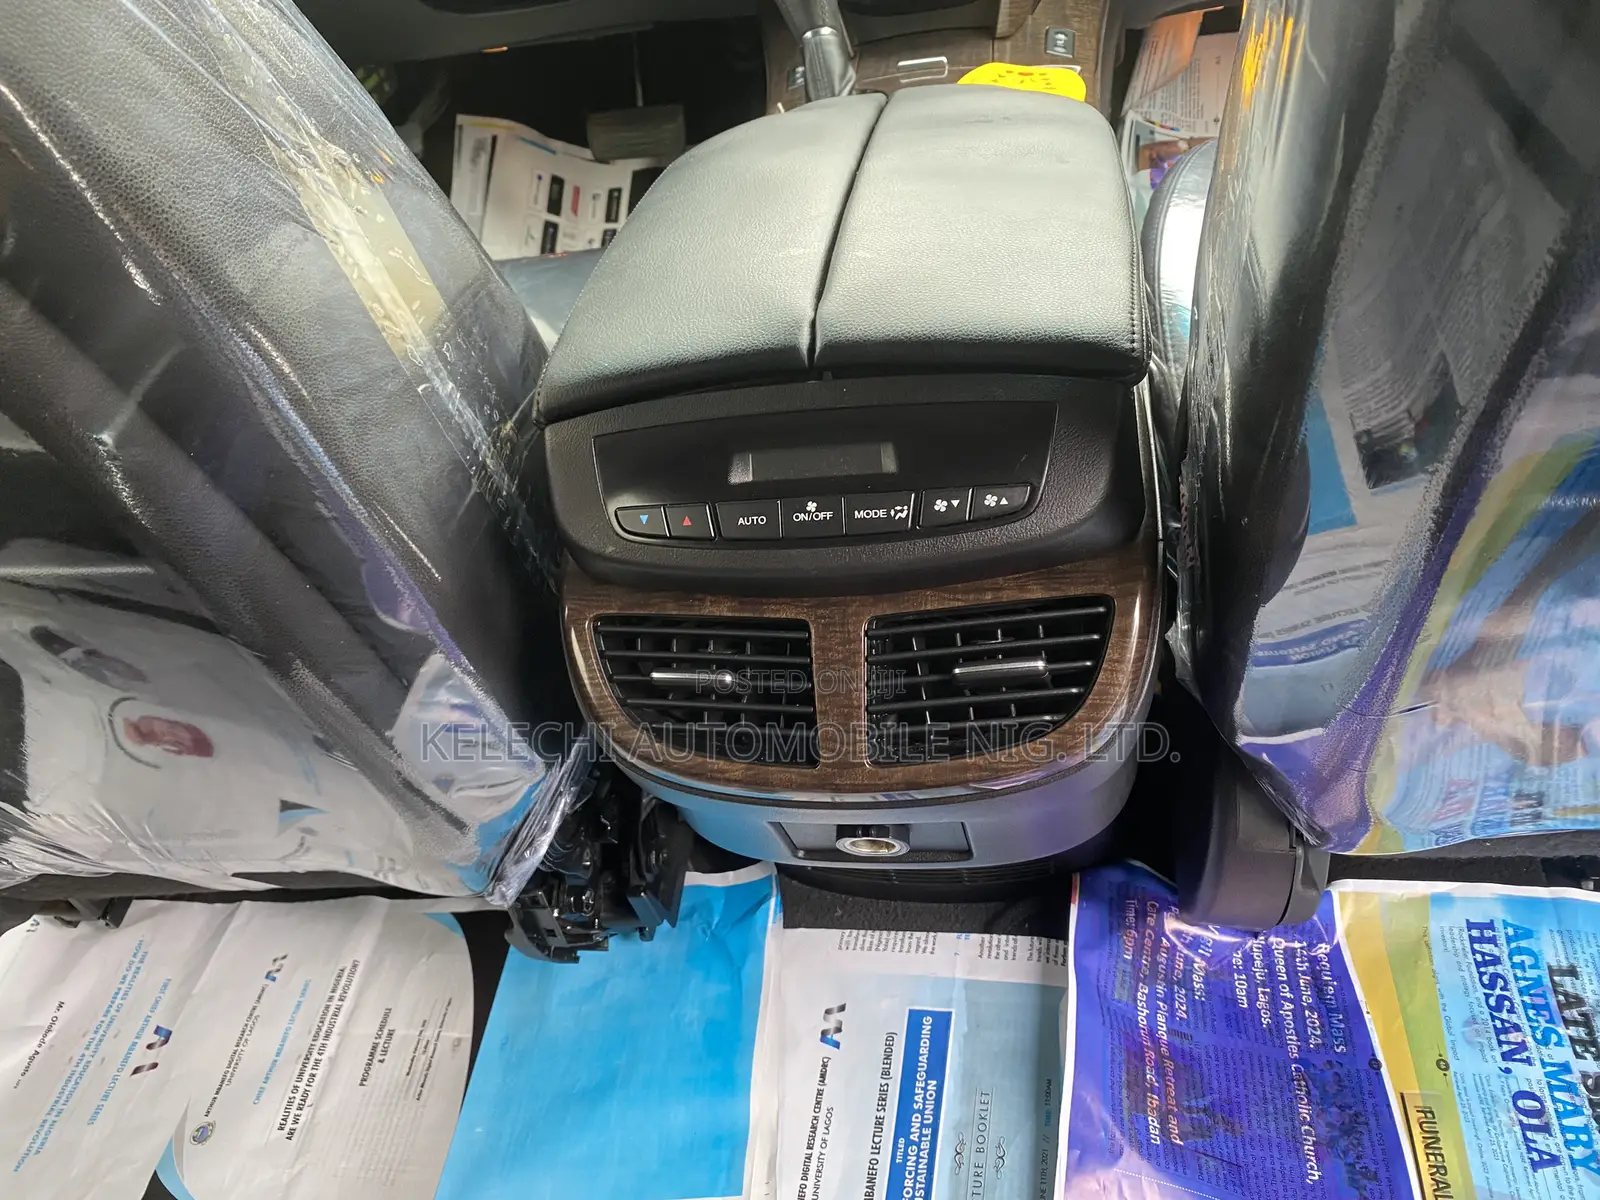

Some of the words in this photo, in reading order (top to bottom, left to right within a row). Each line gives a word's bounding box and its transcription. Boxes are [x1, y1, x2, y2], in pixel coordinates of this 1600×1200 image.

[737, 516, 767, 526] AUTO
[792, 511, 834, 522] ON/OFF
[854, 508, 887, 519] MODE
[1123, 898, 1138, 926] Time:
[1144, 899, 1160, 926] Care
[1121, 928, 1137, 959] 6pm
[1136, 929, 1157, 978] Centre,
[1268, 936, 1290, 981] Queen
[1292, 939, 1312, 971] 14th
[1446, 925, 1460, 958] leadership
[337, 958, 360, 1003] REVOLUTION?
[1152, 936, 1174, 998] Augustin
[1190, 957, 1209, 1002] Mass:
[1456, 960, 1464, 972] and
[326, 993, 335, 1003] IN
[1173, 984, 1186, 1021] 2024.
[1233, 971, 1251, 1009] 10am
[1277, 982, 1293, 1000] of
[1295, 971, 1315, 1007] June,
[1310, 941, 1341, 1011] Requiem
[1327, 1010, 1349, 1054] Mass
[1459, 974, 1471, 998] strategy
[311, 1002, 332, 1043] EDUCATION
[322, 1001, 343, 1042] INDUSTRIAL
[1135, 982, 1153, 1046] Bashorun
[1253, 985, 1275, 1028] Lagos.
[1466, 1000, 1478, 1025] focused
[1546, 963, 1598, 1060] LATE
[358, 1039, 380, 1087] PROGRAMME
[374, 1005, 392, 1040] SCHEDULE
[379, 1026, 395, 1057] LECTURE
[1302, 1008, 1322, 1049] 2024.
[1443, 1016, 1453, 1036] Global
[1449, 1040, 1459, 1061] Impact
[1464, 918, 1532, 1075] HASSAN,
[1510, 1090, 1561, 1173] OLA
[1474, 1028, 1481, 1037] on
[1475, 995, 1483, 1008] and
[1481, 1017, 1491, 1034] 2014
[1486, 1036, 1495, 1052] book
[1491, 1054, 1497, 1064] on
[224, 1048, 246, 1087] UNIVERSITY
[241, 1037, 249, 1047] OF
[246, 1013, 260, 1036] LAGOS
[294, 1041, 317, 1083] UNIVERSITY
[311, 1056, 322, 1072] THE
[316, 1041, 328, 1057] 4TH
[880, 1030, 897, 1080] (BLENDED)
[912, 1015, 933, 1110] SAFEGUARDING
[1477, 1040, 1488, 1064] impact
[1501, 919, 1565, 1048] AGNES
[1538, 1058, 1599, 1176] MARY
[305, 1071, 317, 1087] FOR
[817, 1055, 831, 1086] (AMDRC)
[1141, 1050, 1157, 1088] Road,
[1162, 1059, 1178, 1112] Retreat
[290, 1082, 300, 1095] OF
[296, 1087, 311, 1111] READY
[812, 1087, 824, 1113] CENTRE
[876, 1081, 889, 1112] SERIES
[922, 1078, 937, 1123] UNION
[1289, 1062, 1313, 1122] Catholic
[276, 1094, 297, 1132] REALITIES
[291, 1111, 302, 1124] WE
[822, 1105, 833, 1134] LAGOS
[909, 1112, 921, 1141] AND
[975, 1090, 990, 1153] BOOKLET
[1167, 1113, 1184, 1146] and
[285, 1125, 296, 1141] ARE
[805, 1114, 819, 1150] RESEARCH
[819, 1136, 827, 1149] OF
[870, 1114, 885, 1155] LECTURE
[895, 1137, 905, 1163] TITLED
[800, 1151, 813, 1181] DIGITAL
[1040, 1148, 1048, 1165] 2021
[1296, 1123, 1324, 1185] Church,
[1413, 1105, 1453, 1200] FUNERAL
[811, 1150, 825, 1200] UNIVERSITY
